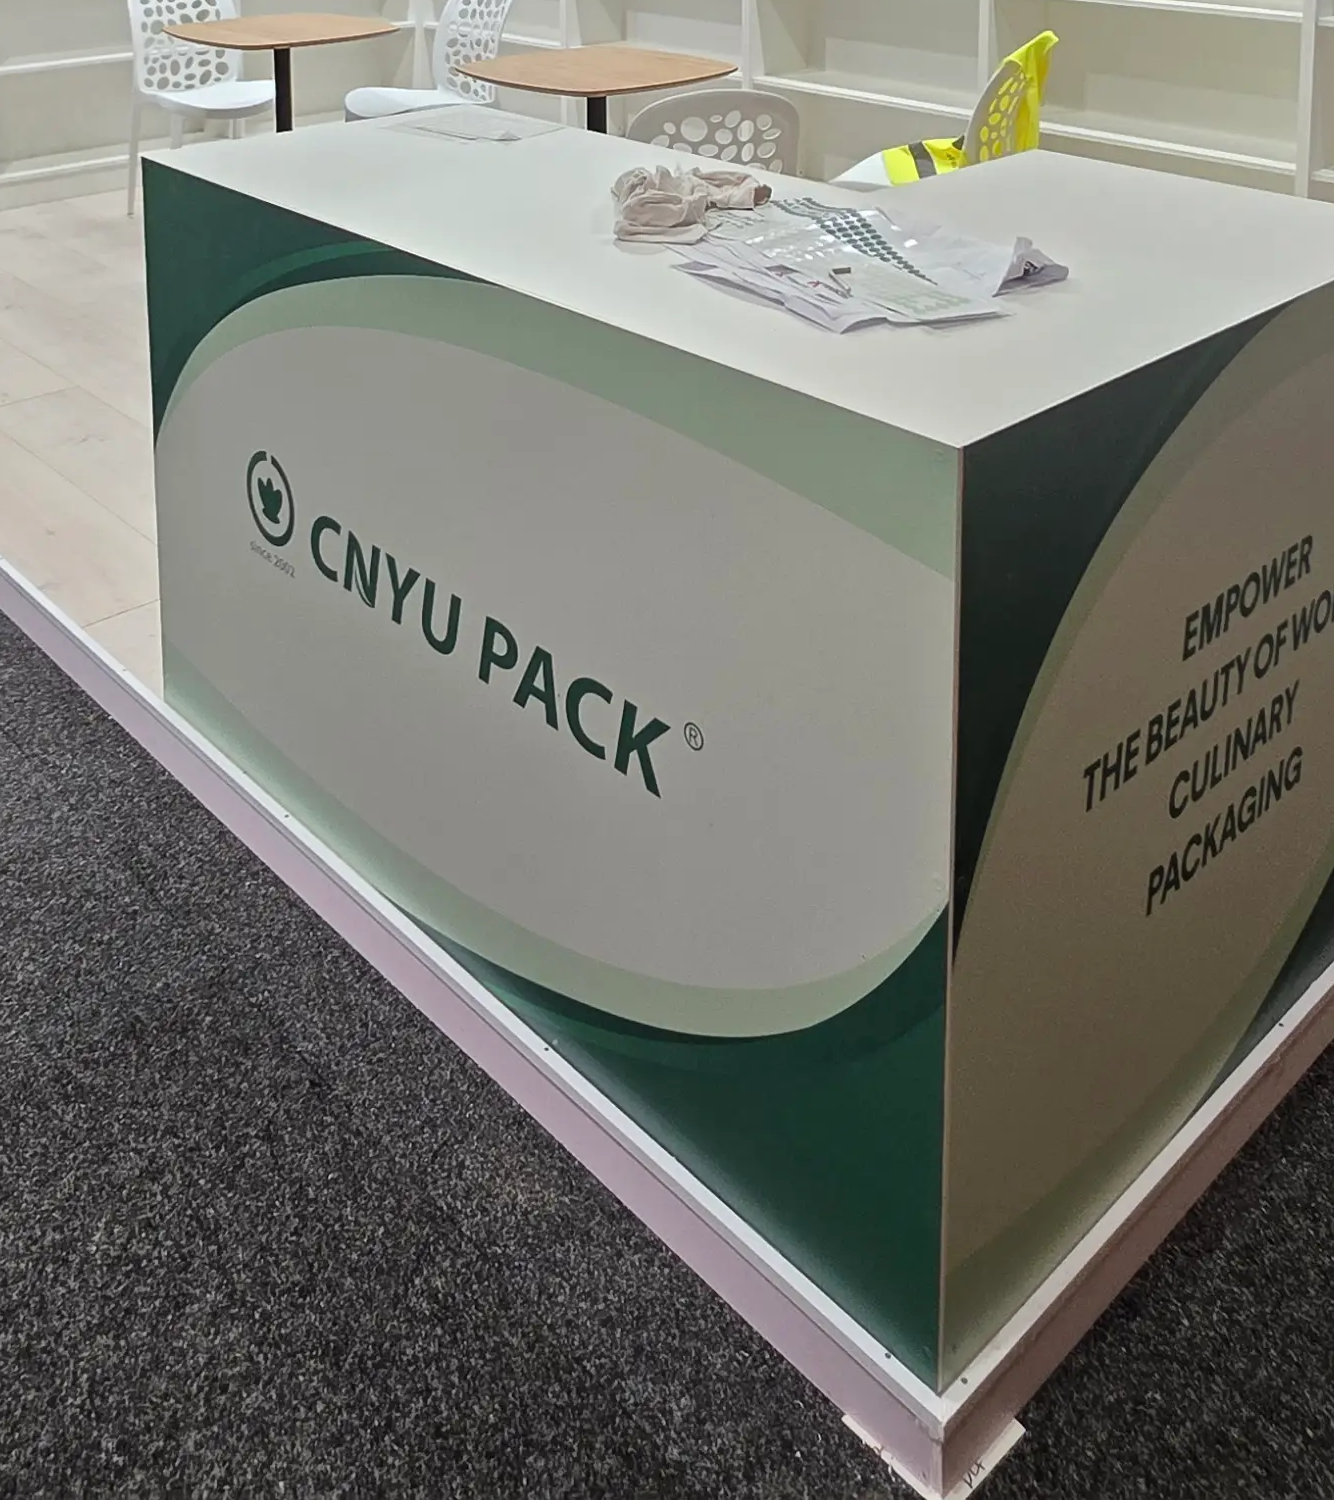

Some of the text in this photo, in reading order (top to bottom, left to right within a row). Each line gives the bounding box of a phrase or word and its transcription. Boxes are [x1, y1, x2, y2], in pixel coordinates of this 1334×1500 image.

[310, 515, 462, 655] CNYU
[477, 615, 671, 799] PACK
[1182, 534, 1313, 662] EMPOWER
[1083, 728, 1141, 813] THE
[1145, 647, 1251, 767] BEAUTY
[1253, 619, 1289, 680] OF
[1169, 678, 1300, 819] CULINARY
[1145, 745, 1303, 917] PACKAGING
